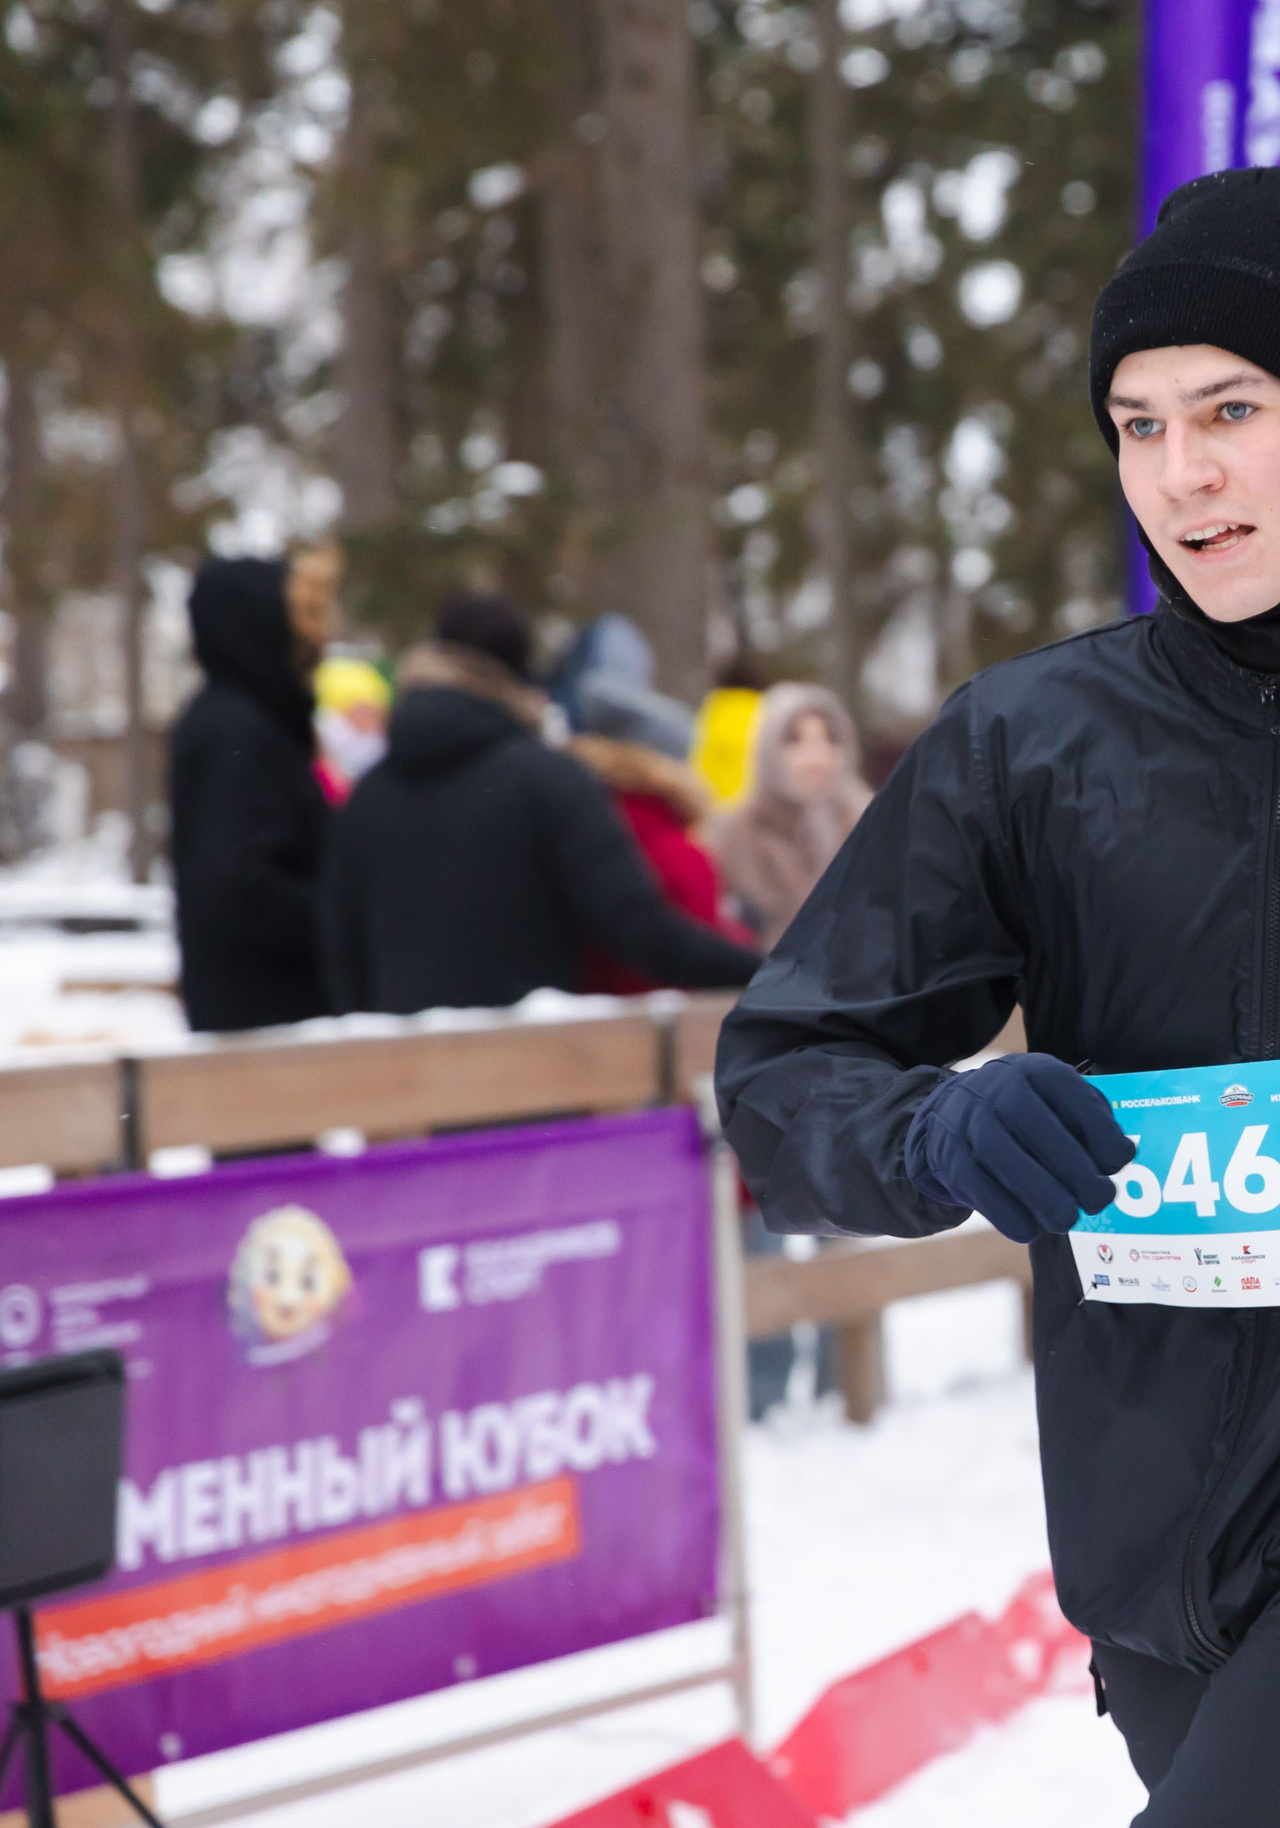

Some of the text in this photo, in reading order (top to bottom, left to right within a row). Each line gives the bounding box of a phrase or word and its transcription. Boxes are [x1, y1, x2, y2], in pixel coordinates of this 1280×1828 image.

[1121, 1095, 1200, 1108] РОССЕЛЬХОЗБАНК
[1241, 1276, 1260, 1285] ПАПА
[116, 1396, 432, 1572] МЕННЫЙ
[439, 1372, 656, 1499] КУБОК
